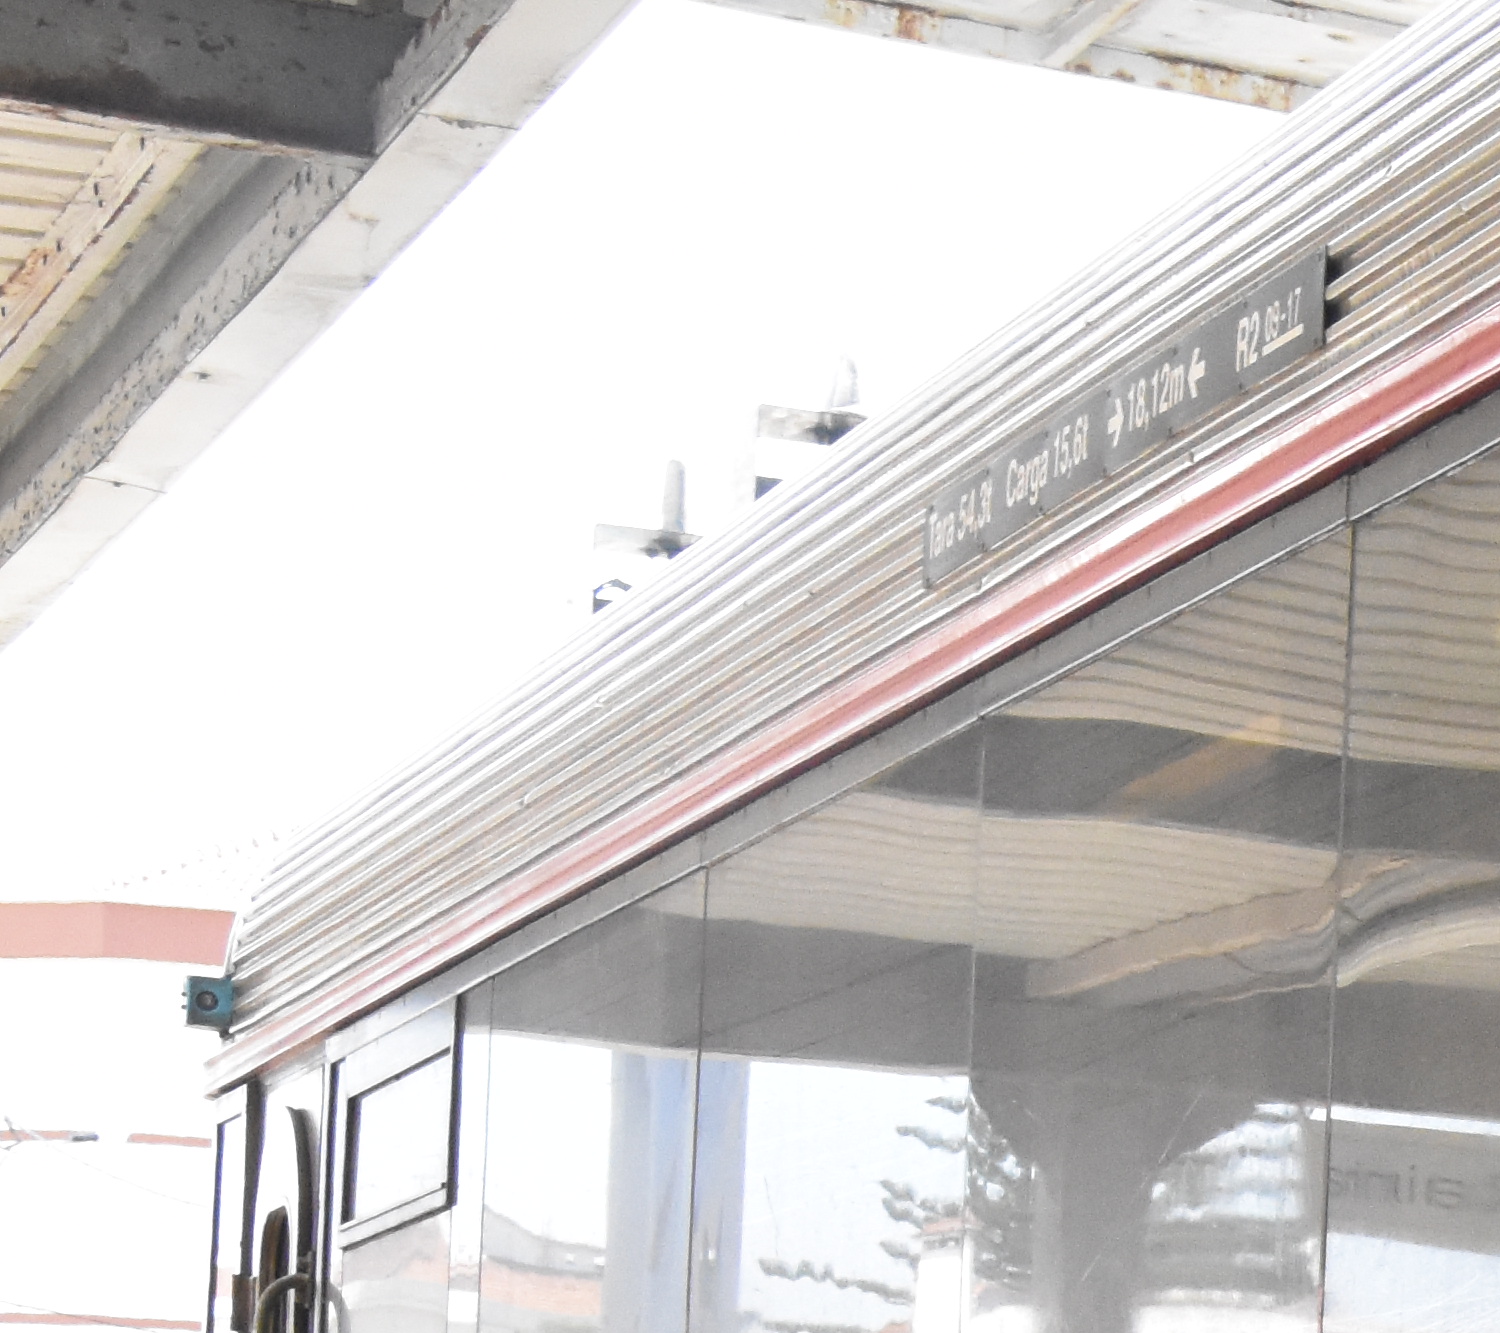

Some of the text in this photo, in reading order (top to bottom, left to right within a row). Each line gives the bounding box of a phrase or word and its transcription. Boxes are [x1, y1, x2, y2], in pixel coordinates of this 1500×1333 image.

[929, 511, 955, 560] Tara
[957, 479, 993, 539] 54,3t
[1005, 450, 1049, 508] Carga
[1053, 414, 1089, 479] 15,6t
[1127, 361, 1185, 434] 18,12m
[1236, 311, 1260, 373] R2
